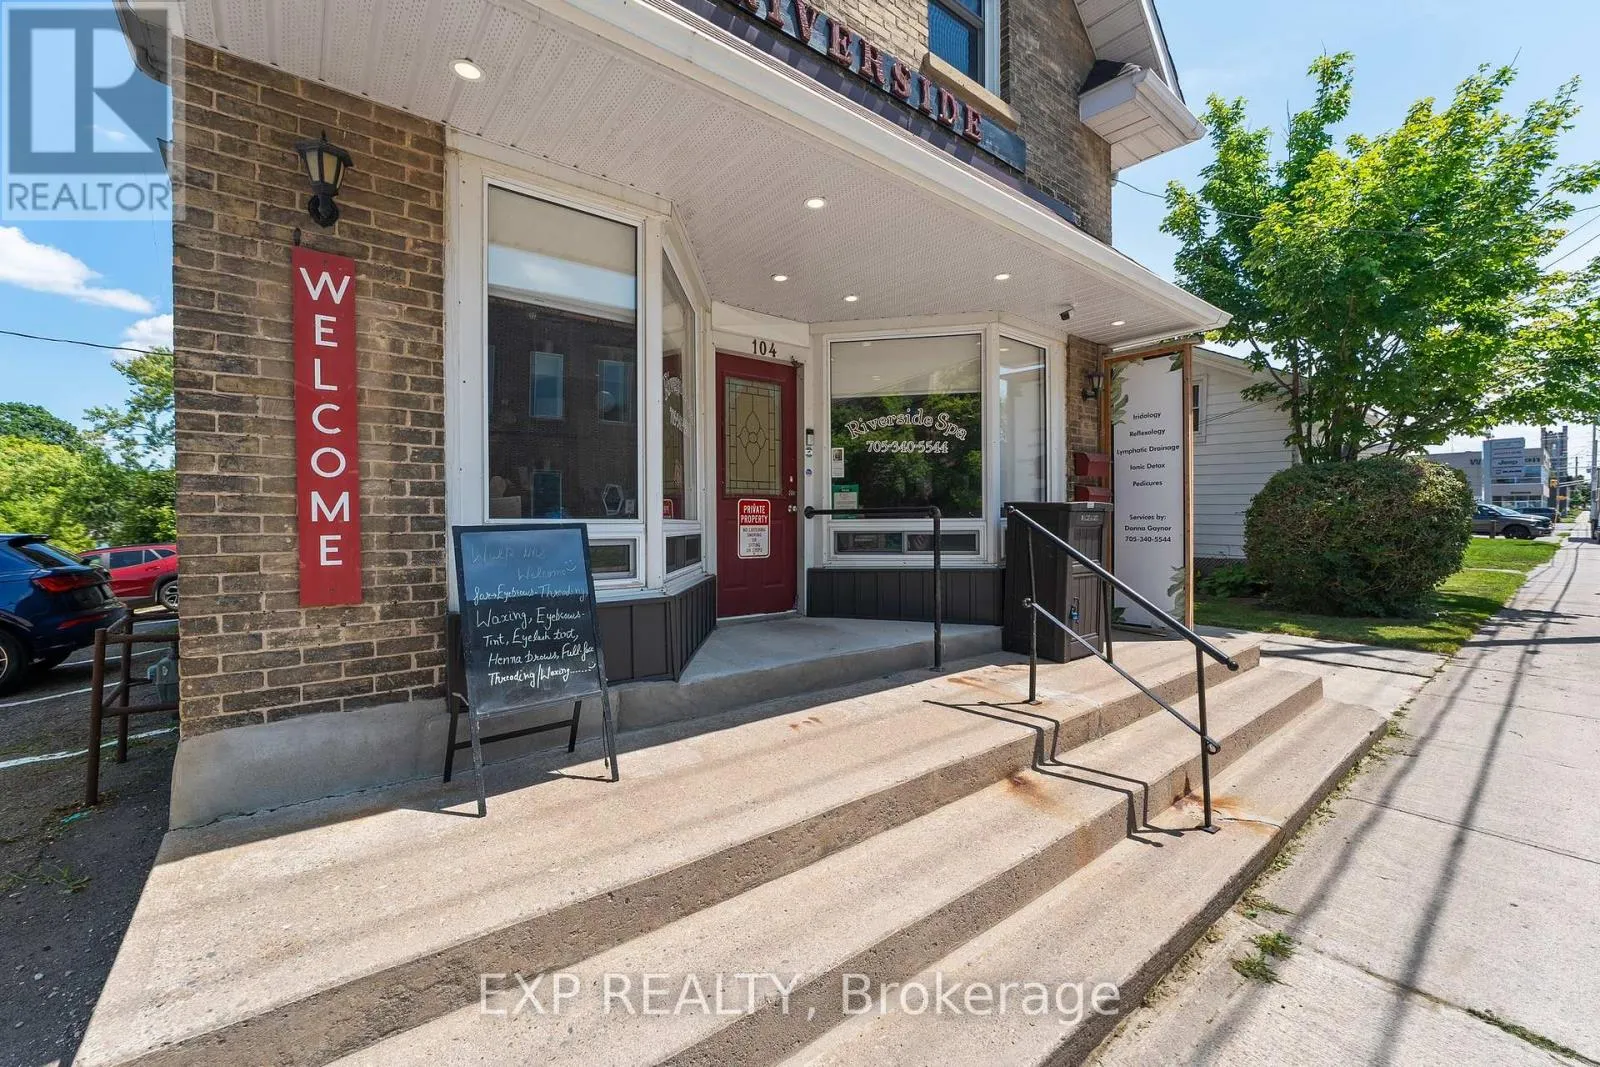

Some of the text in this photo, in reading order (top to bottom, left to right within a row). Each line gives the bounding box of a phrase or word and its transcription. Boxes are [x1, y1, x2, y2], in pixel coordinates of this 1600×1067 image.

[745, 0, 983, 144] IVERSIDE
[752, 339, 777, 357] 104
[299, 267, 350, 566] WELCOME
[1132, 411, 1162, 420] Iridology
[844, 407, 968, 441] Riverside Spa
[1129, 428, 1166, 437] Reflexology
[866, 440, 949, 454] 705-340-5544
[1116, 444, 1180, 456] Lymphatic Drainage
[1146, 462, 1166, 470] Detox
[743, 505, 766, 514] PRIVATE
[741, 515, 768, 524] PROPERTY
[1155, 513, 1168, 521] by:
[1147, 525, 1172, 533] Gaynor
[488, 652, 523, 667] Henna
